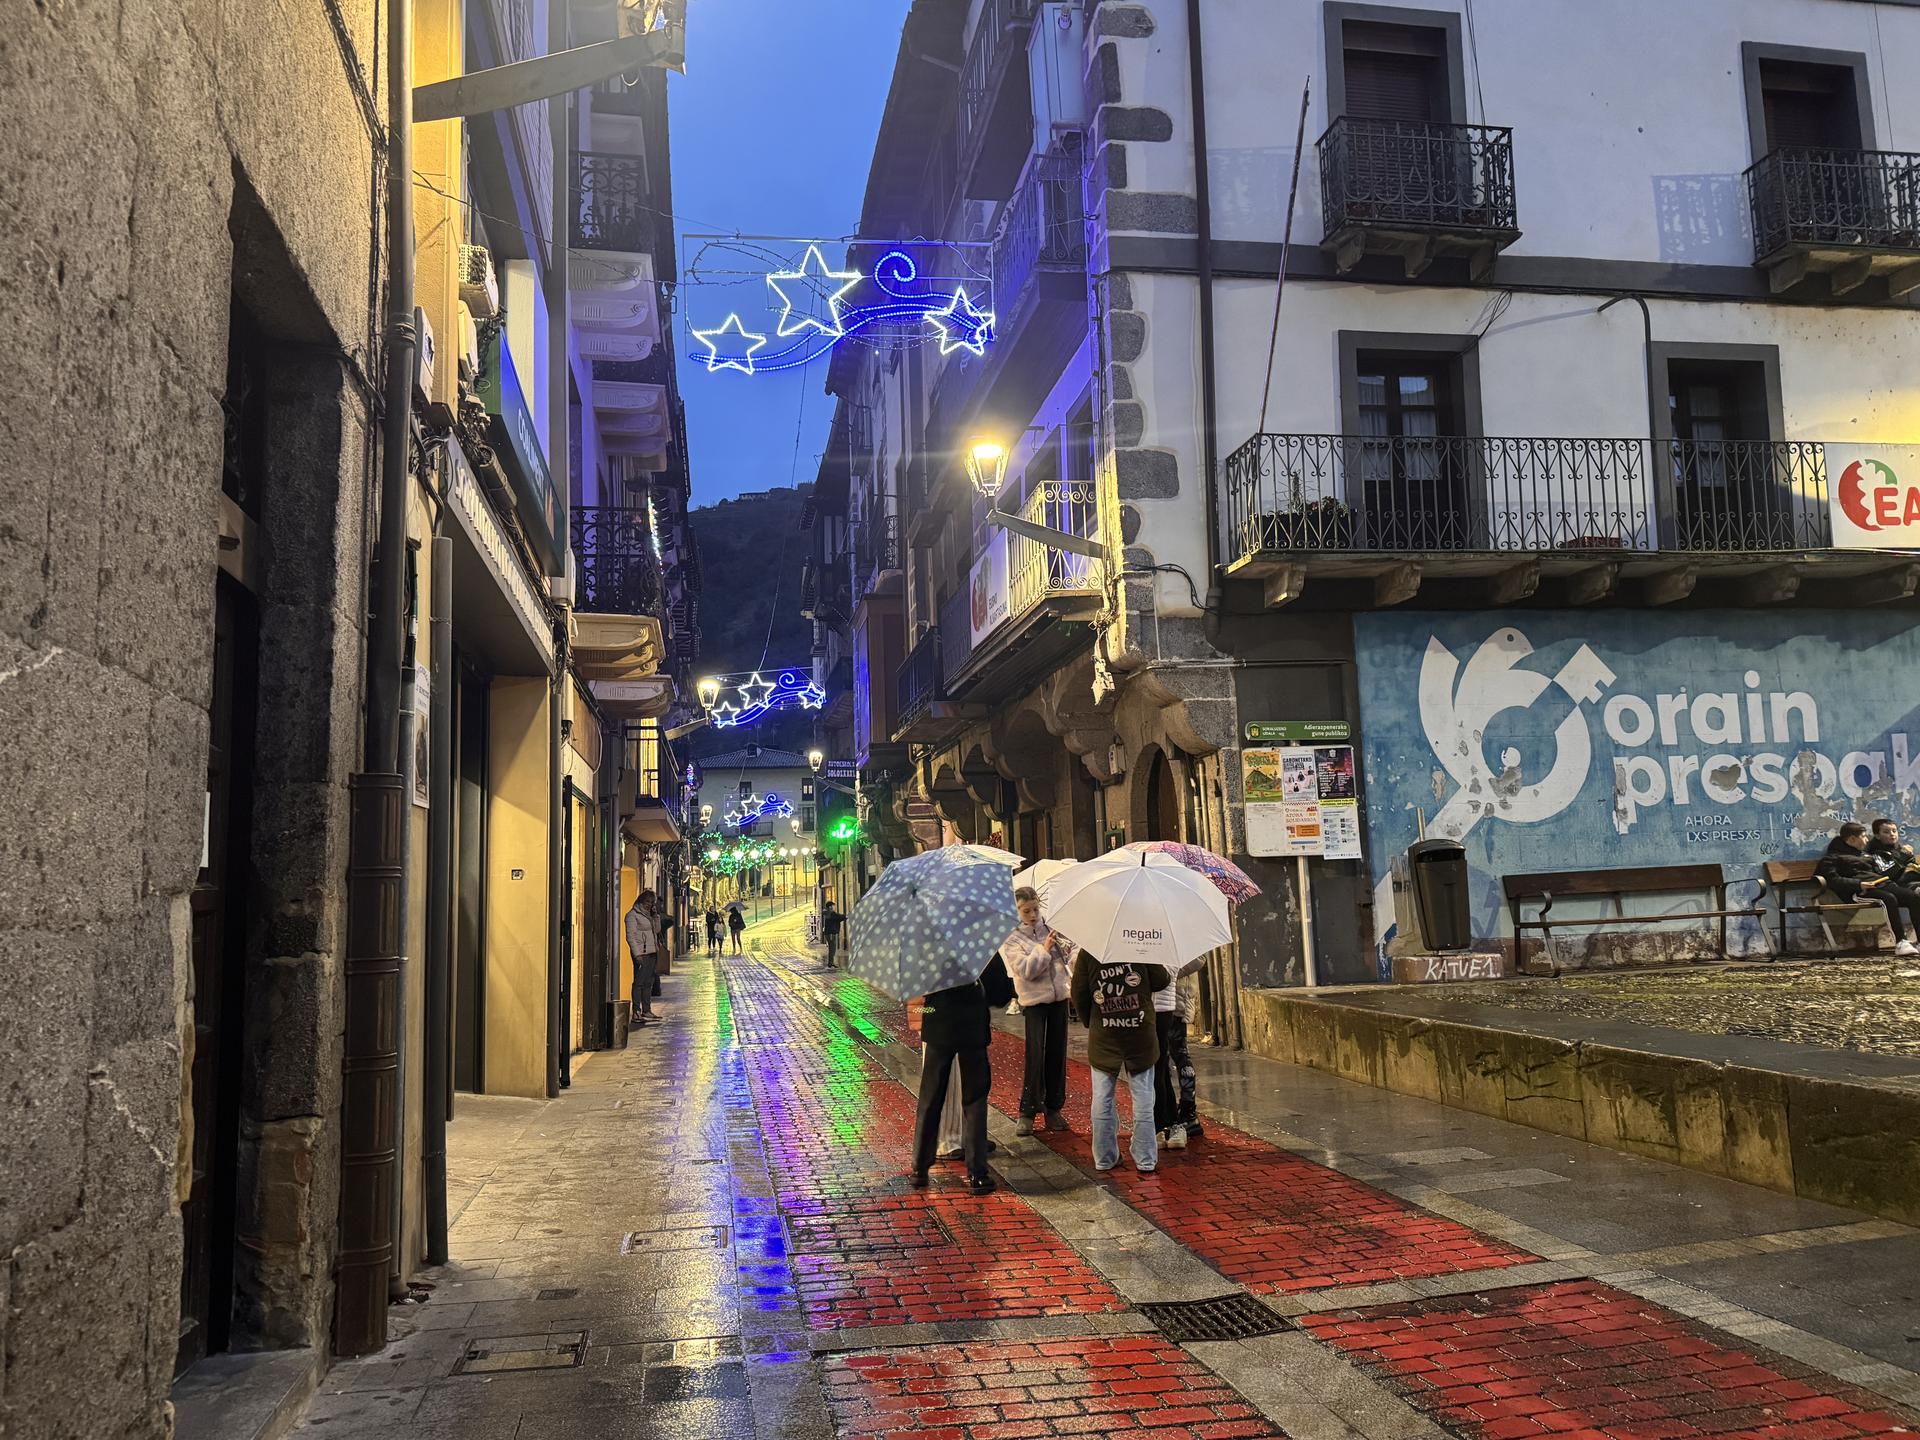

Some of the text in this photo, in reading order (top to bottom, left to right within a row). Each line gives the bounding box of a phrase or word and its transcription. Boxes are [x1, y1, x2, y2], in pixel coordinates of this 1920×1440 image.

[1874, 487, 1920, 526] EA
[1603, 670, 1820, 747] orain
[1685, 815, 1733, 827] AHORA
[1686, 830, 1761, 842] LXS PRESXS
[1122, 928, 1162, 941] negabi
[1100, 963, 1133, 980] DON'T
[1097, 980, 1125, 996] YOU
[1102, 1010, 1145, 1027] DANCE?
